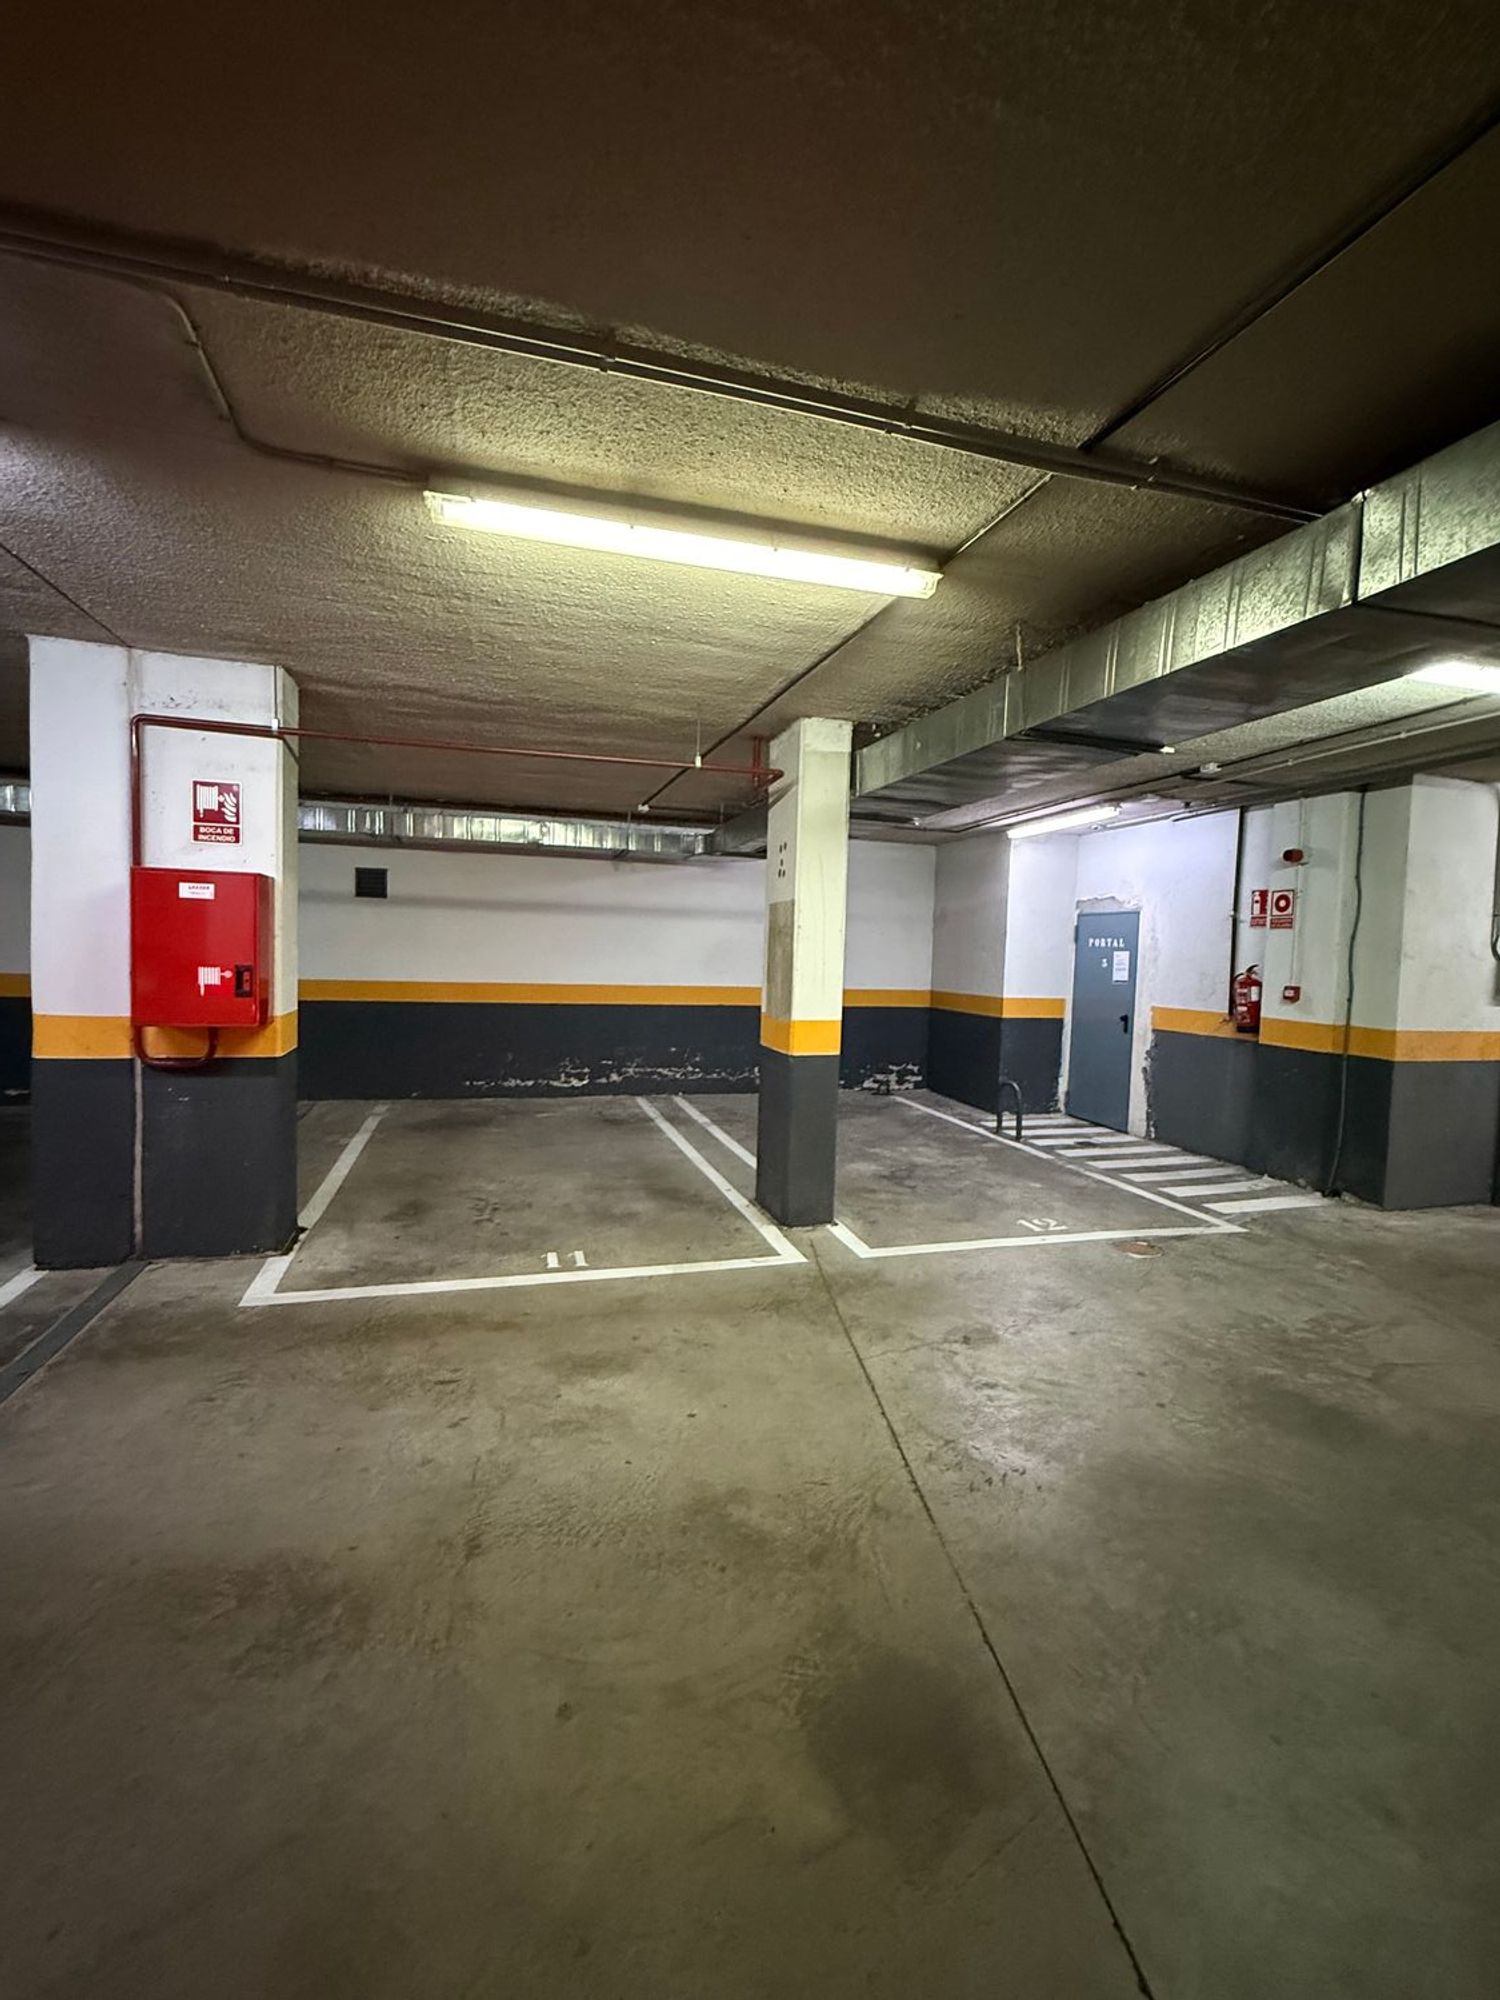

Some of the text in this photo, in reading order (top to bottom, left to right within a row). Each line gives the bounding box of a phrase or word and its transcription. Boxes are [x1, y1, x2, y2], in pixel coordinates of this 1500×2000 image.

[198, 834, 236, 842] INCENDIO
[1088, 938, 1125, 948] PORTAL
[1016, 1218, 1068, 1231] 12
[541, 1250, 589, 1269] 11
